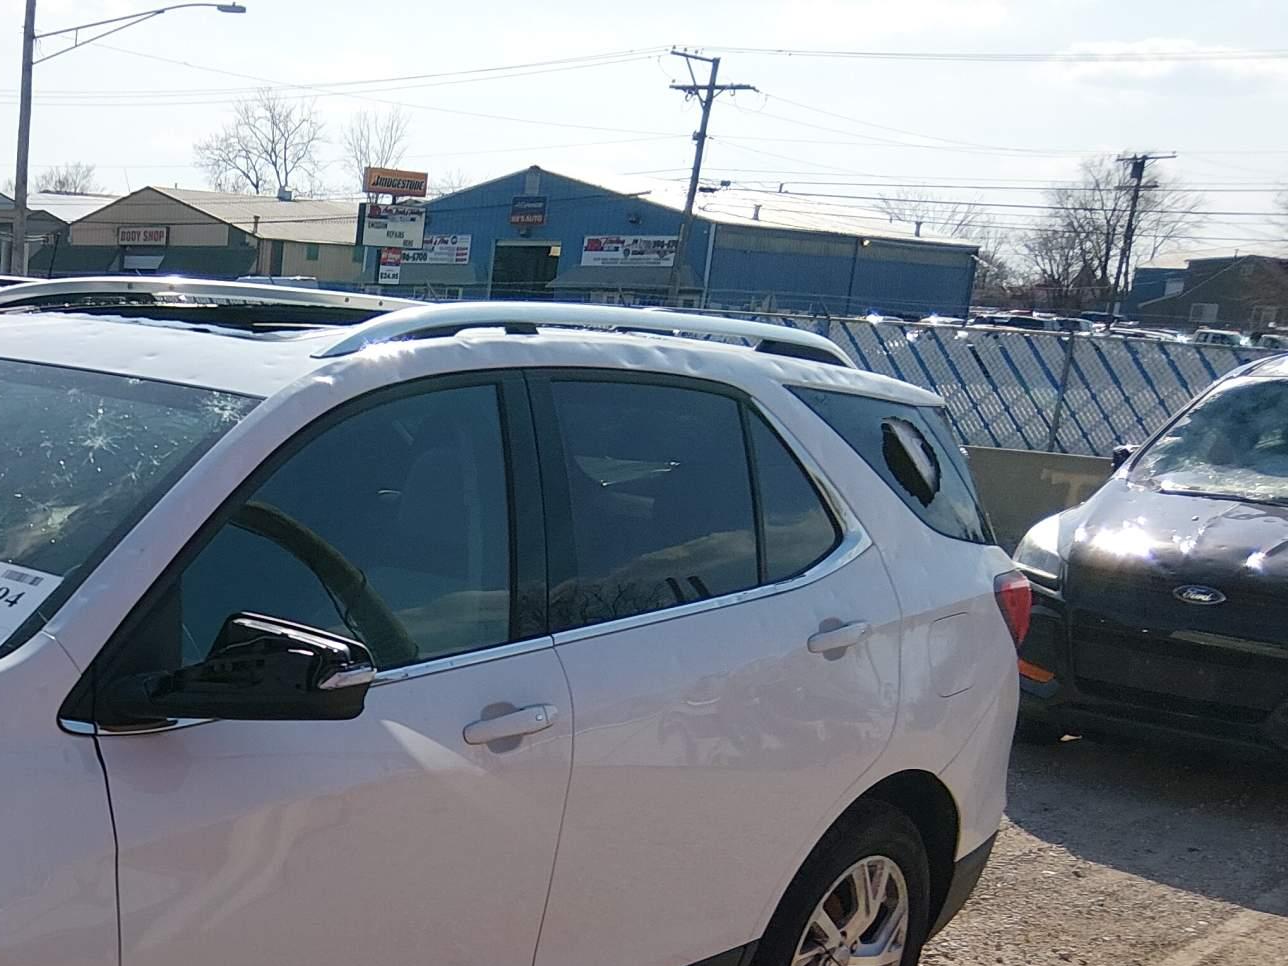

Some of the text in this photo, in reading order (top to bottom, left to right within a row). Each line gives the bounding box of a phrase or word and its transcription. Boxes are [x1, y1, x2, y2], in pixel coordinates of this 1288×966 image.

[372, 176, 424, 191] BRIDGESTONE
[120, 230, 165, 241] BODY SHOP
